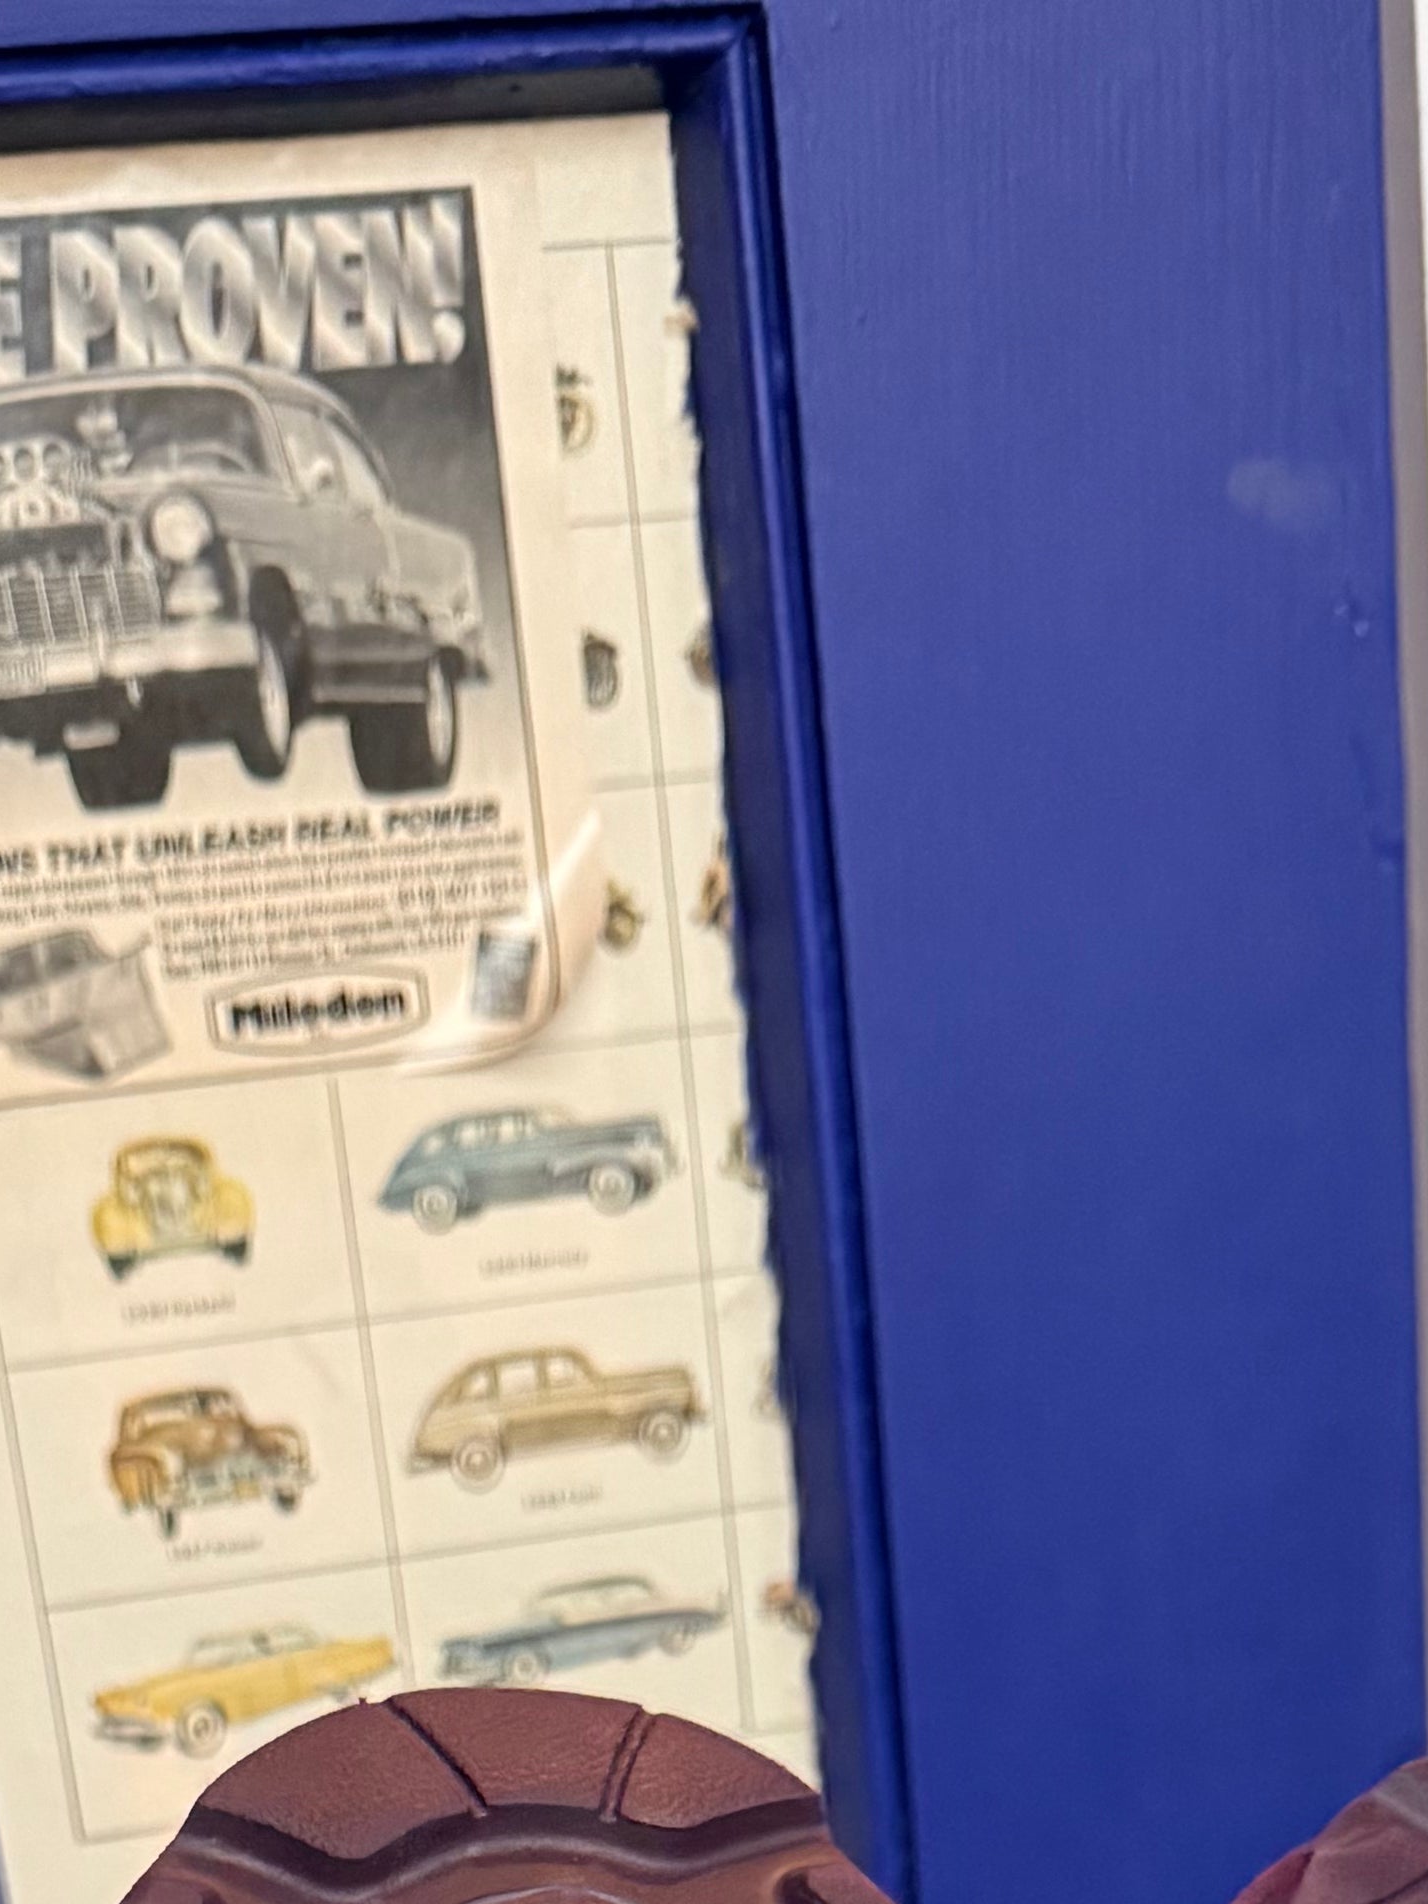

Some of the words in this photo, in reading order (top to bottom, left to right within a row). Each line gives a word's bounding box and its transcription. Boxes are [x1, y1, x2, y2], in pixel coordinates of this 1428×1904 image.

[50, 199, 465, 375] PROVEN!
[43, 835, 128, 872] THAT
[134, 820, 289, 861] UNLEASH
[292, 812, 371, 843] REAL
[380, 800, 502, 837] POWER
